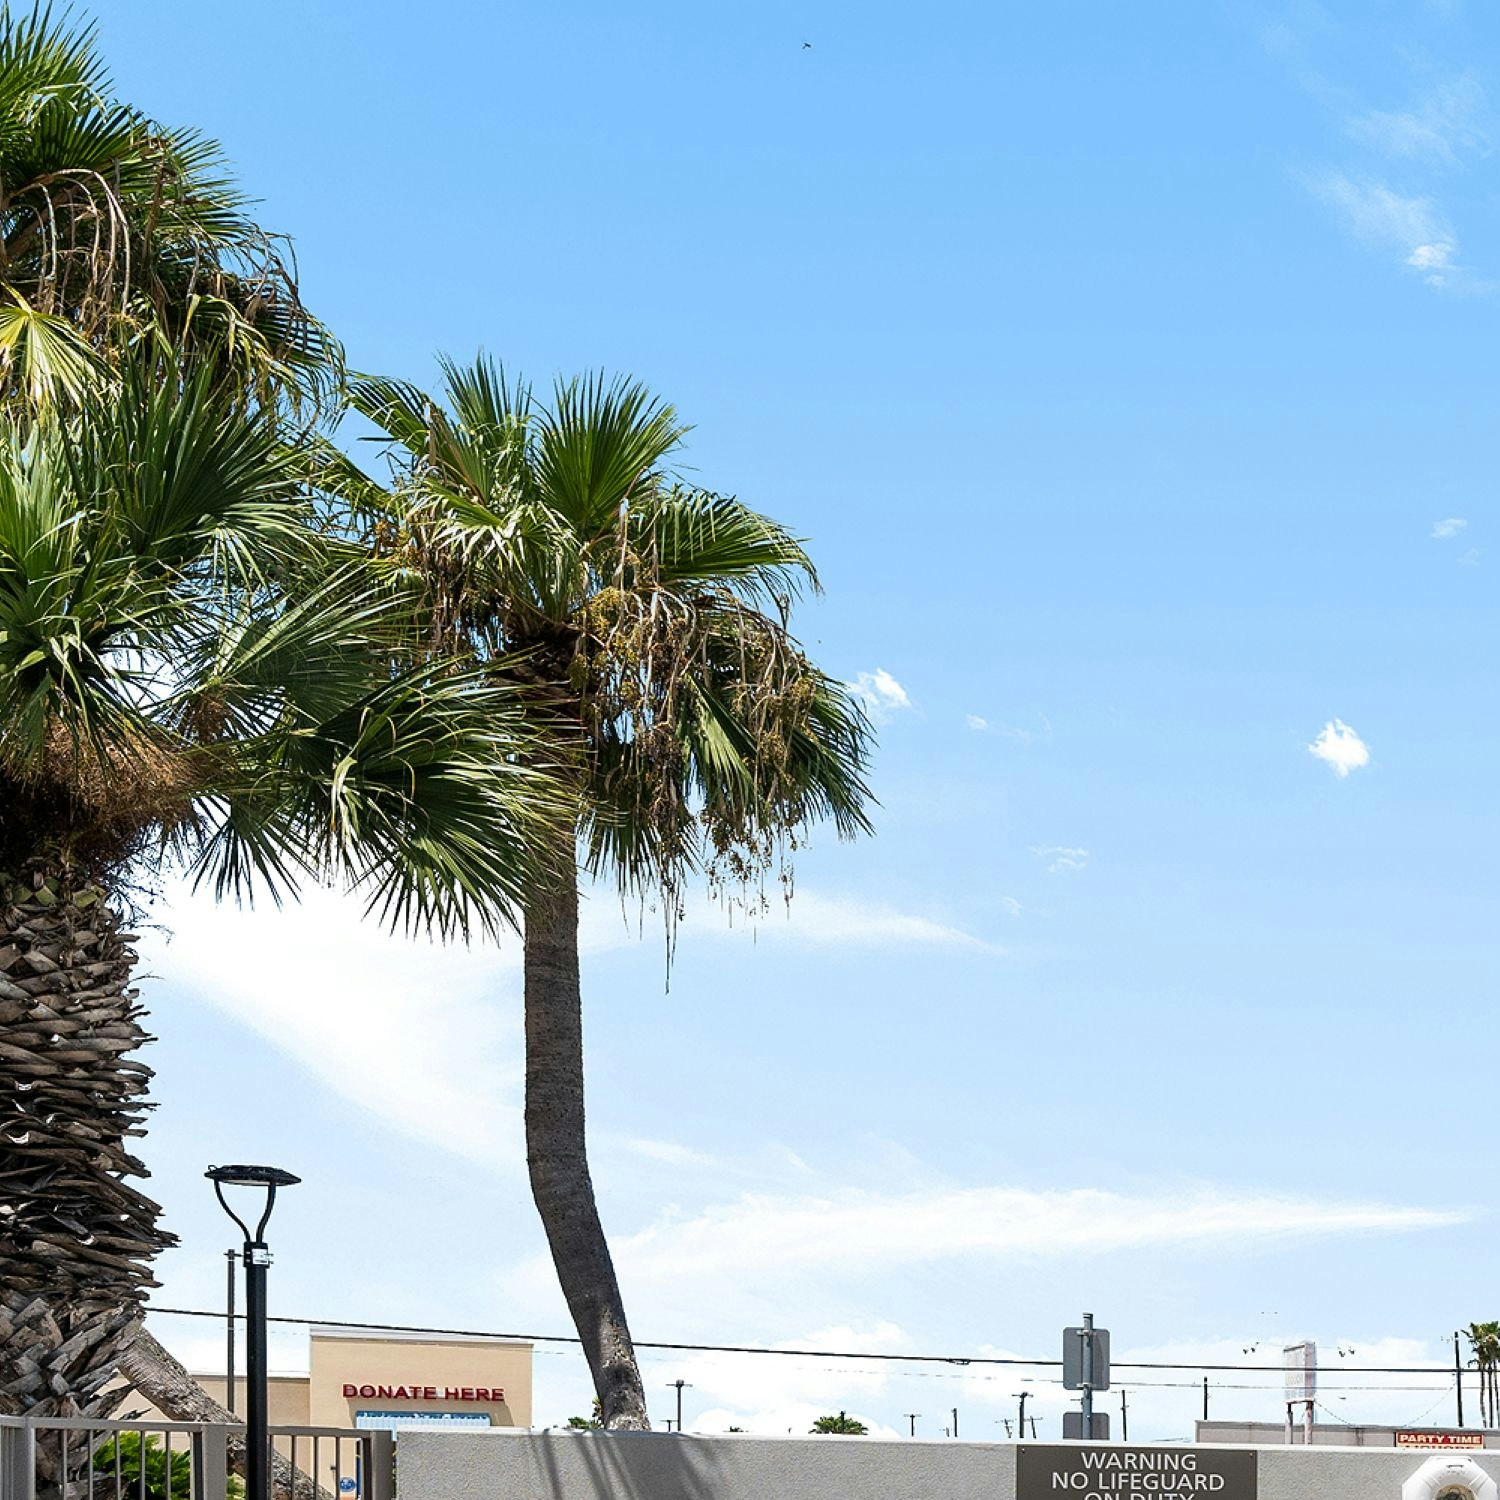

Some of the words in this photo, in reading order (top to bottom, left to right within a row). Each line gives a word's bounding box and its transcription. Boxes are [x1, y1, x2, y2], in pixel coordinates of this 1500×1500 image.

[343, 1384, 437, 1400] DONATE
[445, 1387, 505, 1401] HERE
[1400, 1434, 1444, 1443] PARTY
[1081, 1452, 1196, 1471] WARNING
[1052, 1472, 1088, 1490] NO
[1099, 1473, 1225, 1491] LIFEGUARD
